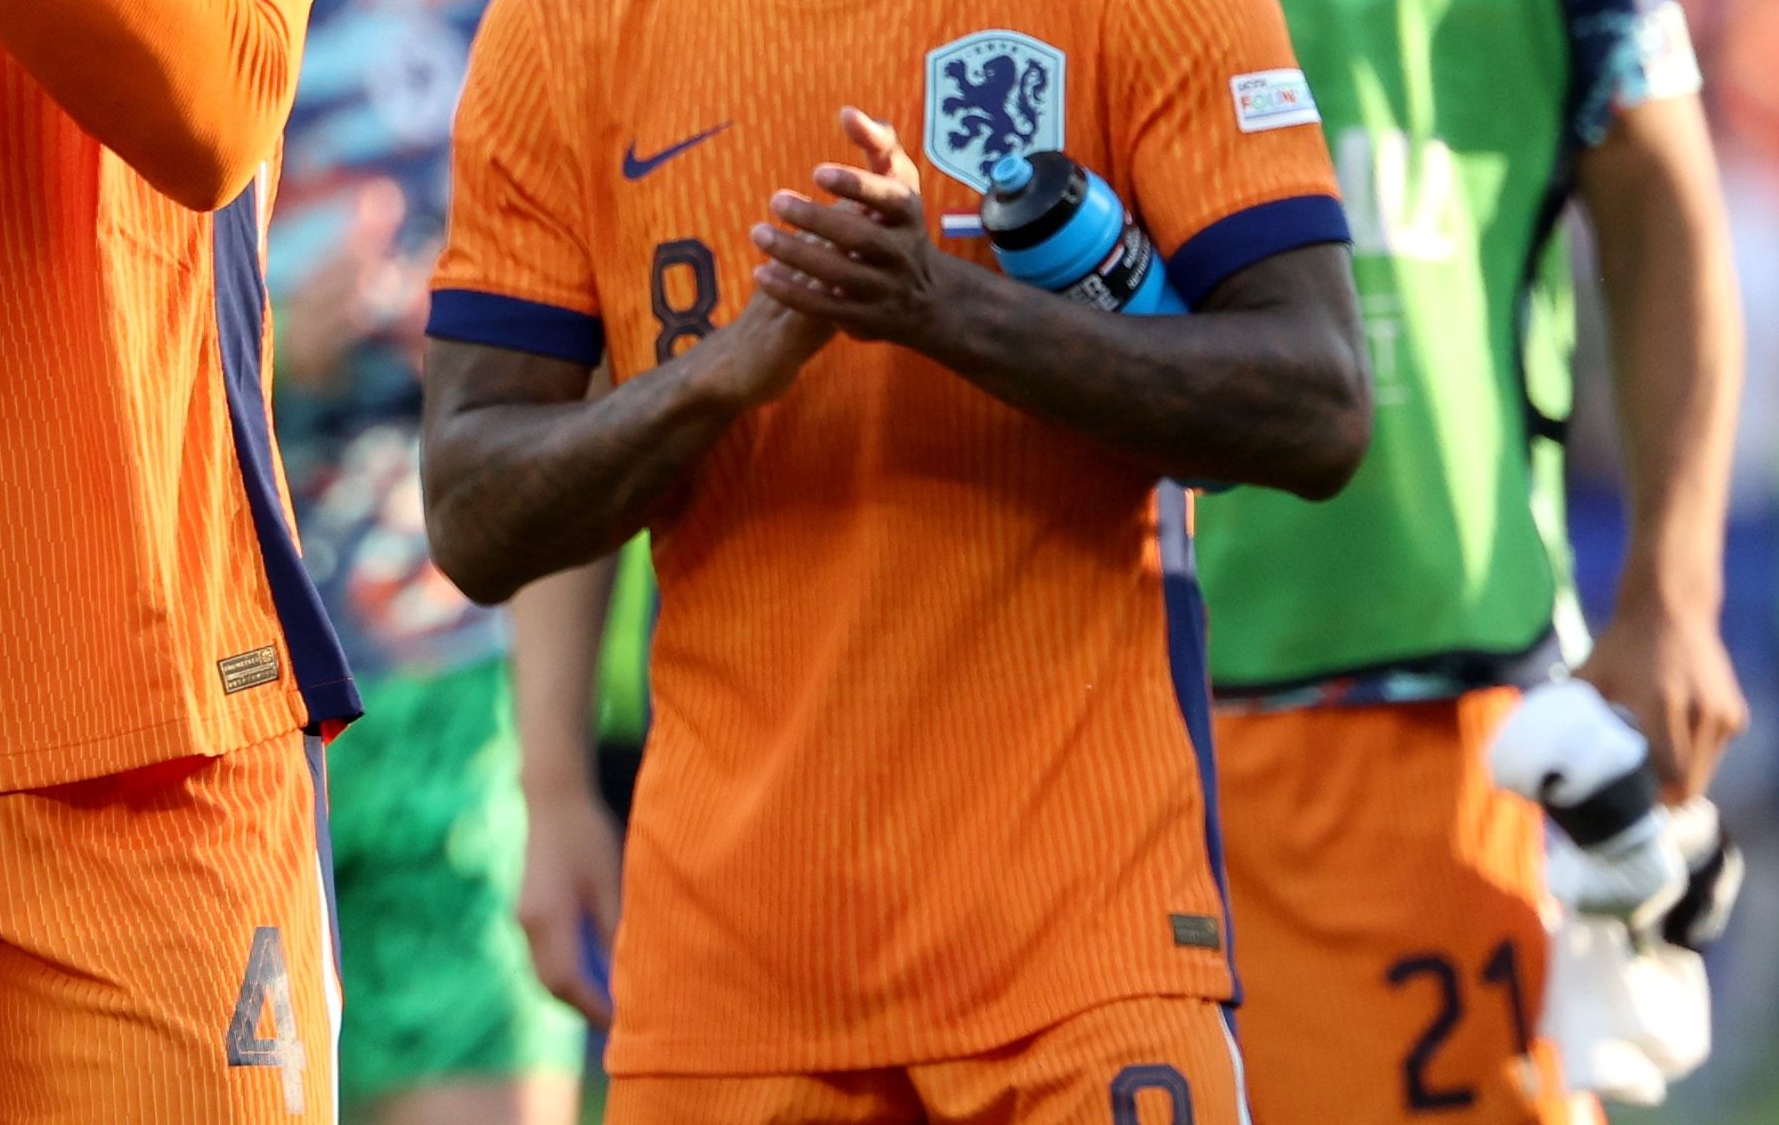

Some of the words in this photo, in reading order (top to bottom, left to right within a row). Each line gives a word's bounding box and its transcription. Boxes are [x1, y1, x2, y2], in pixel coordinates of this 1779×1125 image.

[651, 238, 718, 366] 8
[226, 926, 306, 1115] 4
[1386, 939, 1533, 1113] 21
